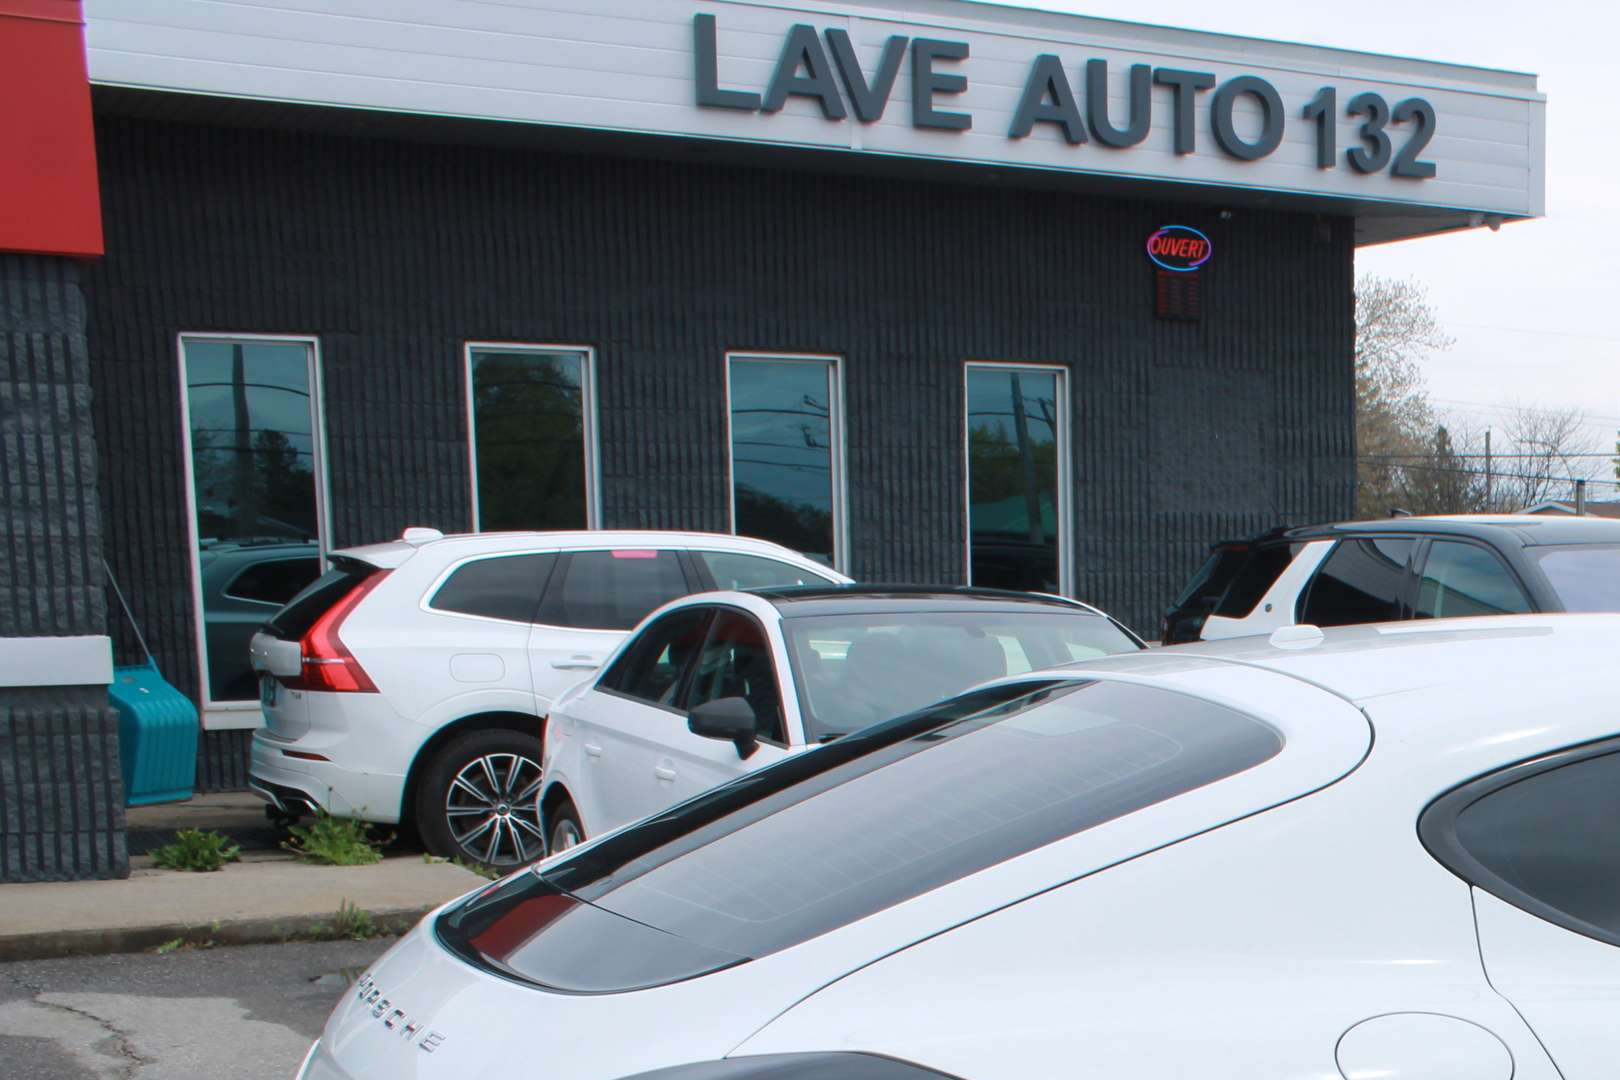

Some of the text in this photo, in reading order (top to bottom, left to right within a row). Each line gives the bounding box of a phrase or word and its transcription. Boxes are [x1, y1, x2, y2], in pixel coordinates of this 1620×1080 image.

[694, 13, 1437, 179] LAVE AUTO 132
[1150, 236, 1206, 259] OUVERT
